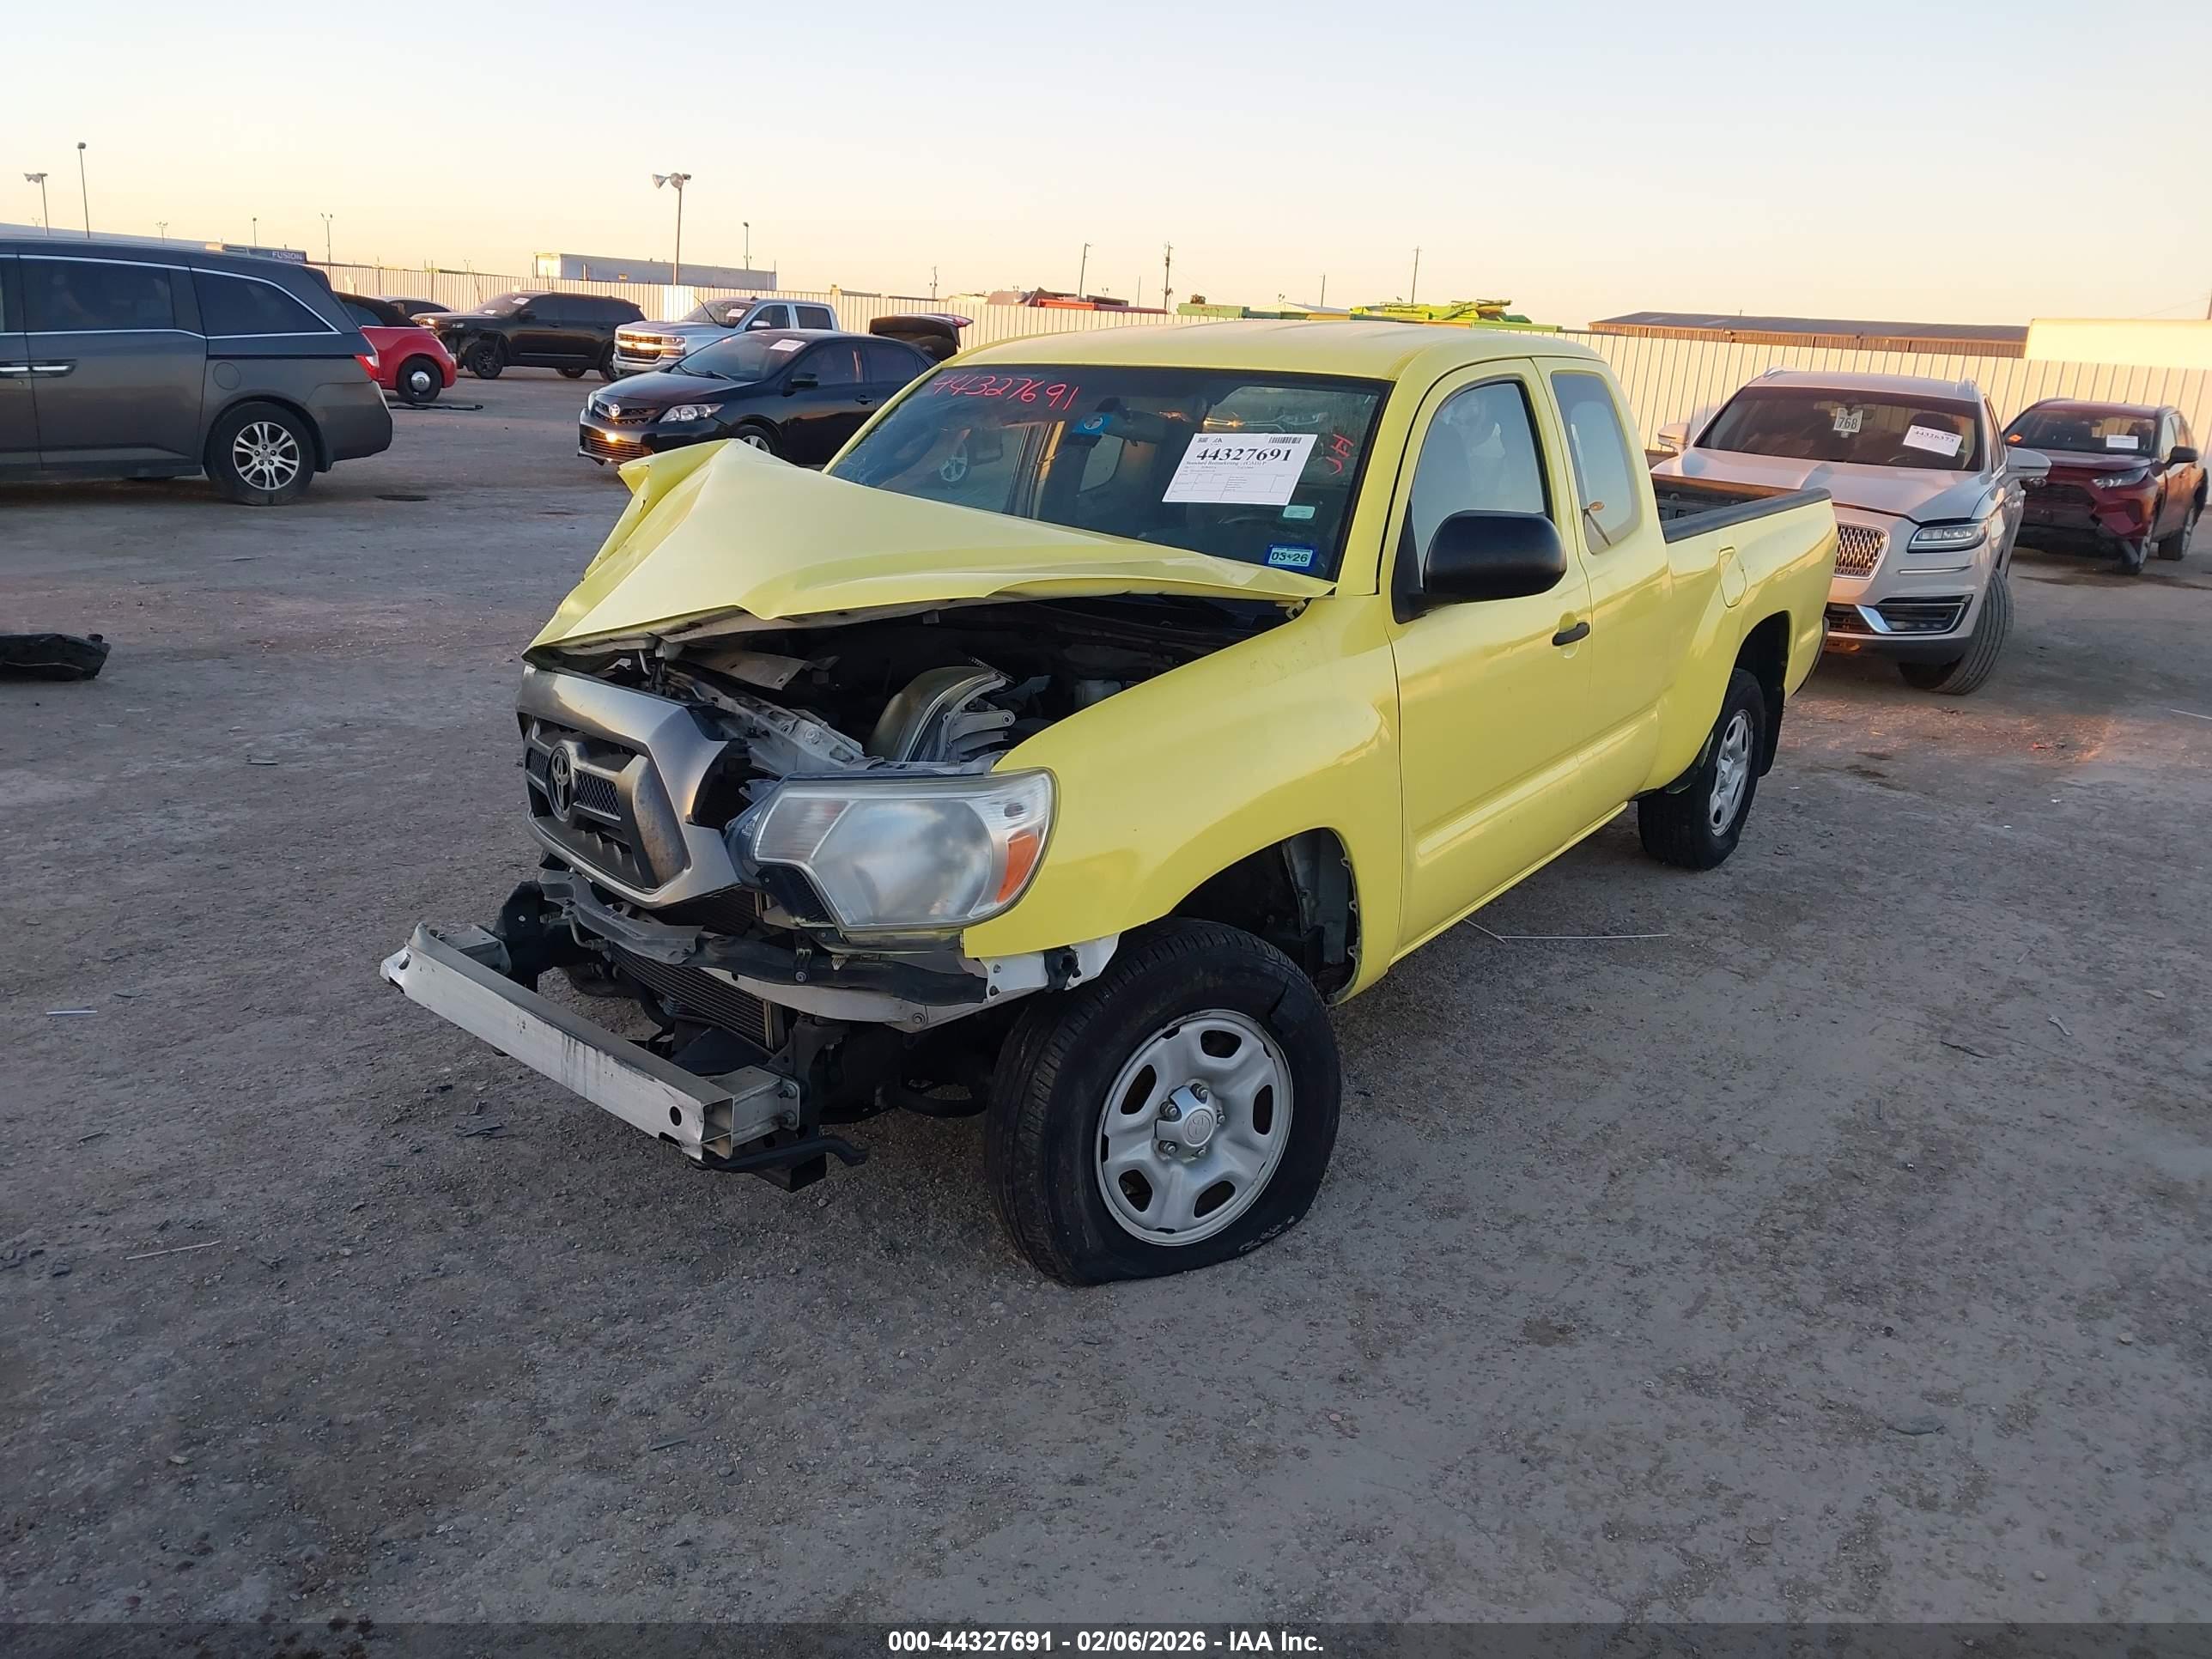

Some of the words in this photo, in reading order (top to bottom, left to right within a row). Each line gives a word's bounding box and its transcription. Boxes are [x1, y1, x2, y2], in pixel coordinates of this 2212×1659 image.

[271, 251, 303, 260] FUSION
[933, 374, 1079, 410] 44327691
[1838, 416, 1858, 429] 768
[1196, 447, 1292, 461] 44327691
